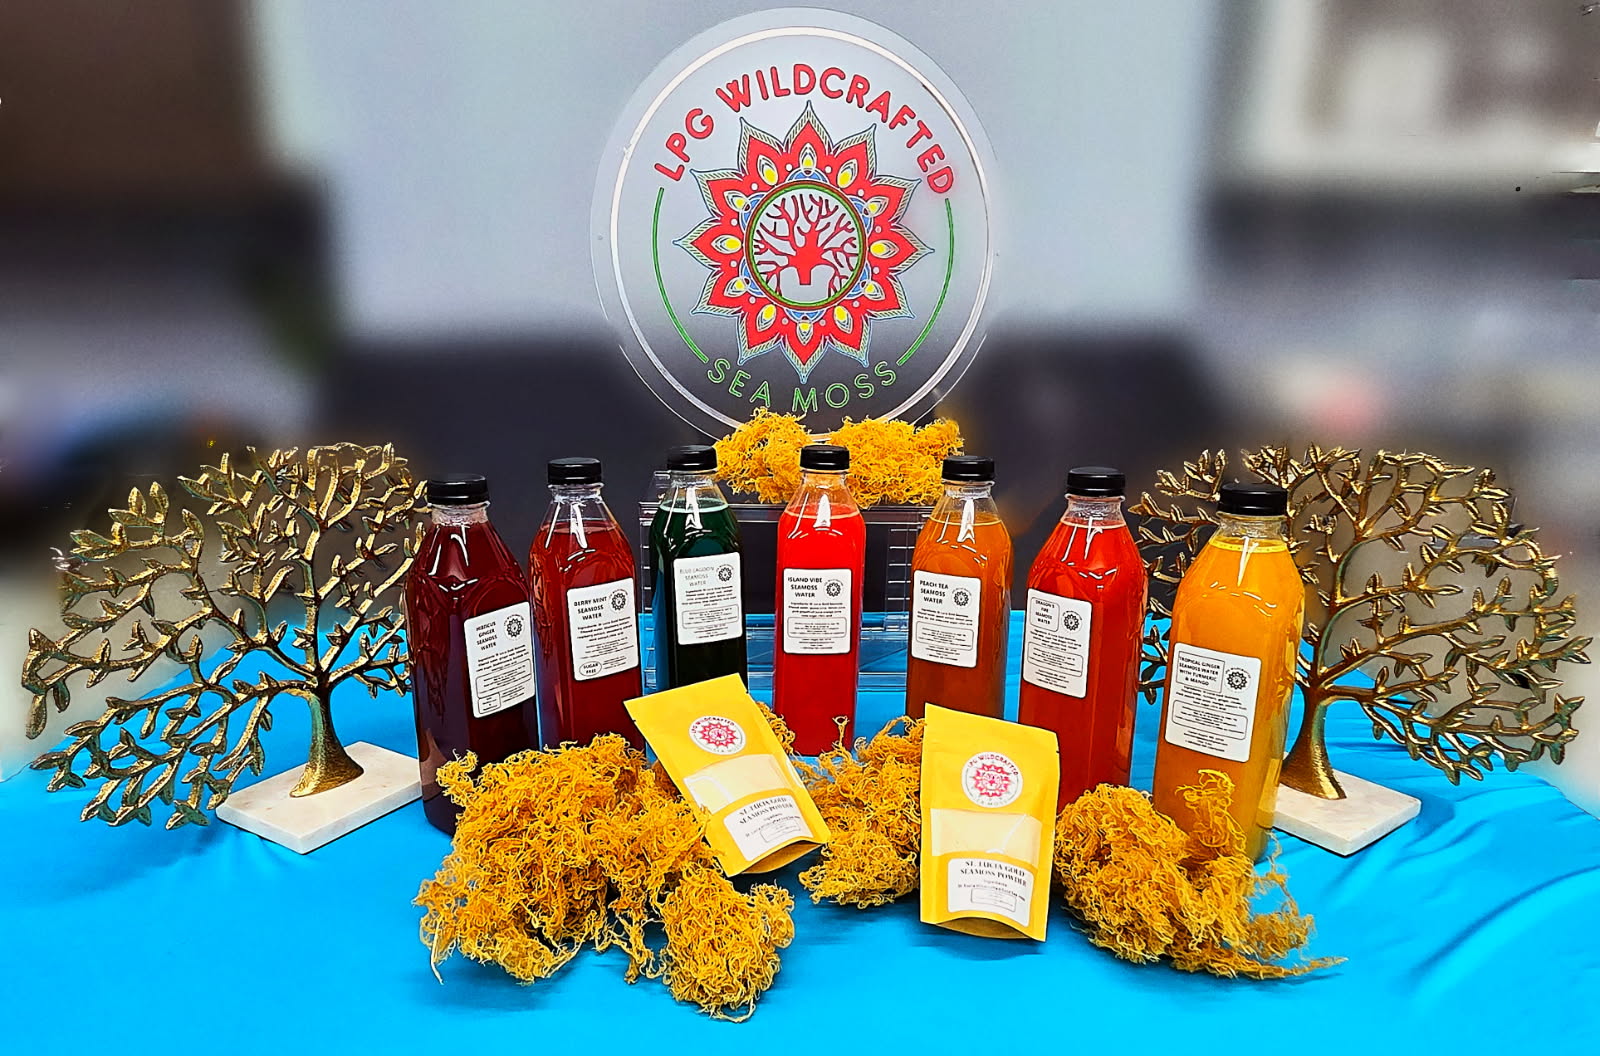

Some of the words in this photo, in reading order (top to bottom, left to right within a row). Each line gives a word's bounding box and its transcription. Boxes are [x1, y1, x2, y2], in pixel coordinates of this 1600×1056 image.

[654, 107, 714, 182] LPG
[715, 63, 955, 194] WILDCRAFTED
[706, 357, 771, 407] SEA
[792, 360, 897, 412] MOSS
[919, 579, 937, 588] PEACH
[938, 582, 949, 590] TEA
[920, 588, 946, 597] SEAMOSS
[573, 598, 592, 607] BERRY
[592, 596, 608, 604] MINT
[923, 596, 943, 605] WATER
[577, 604, 604, 614] SEAMOSS
[582, 612, 602, 621] WATER
[480, 641, 497, 651] WATER
[997, 871, 1027, 887] POWDER
